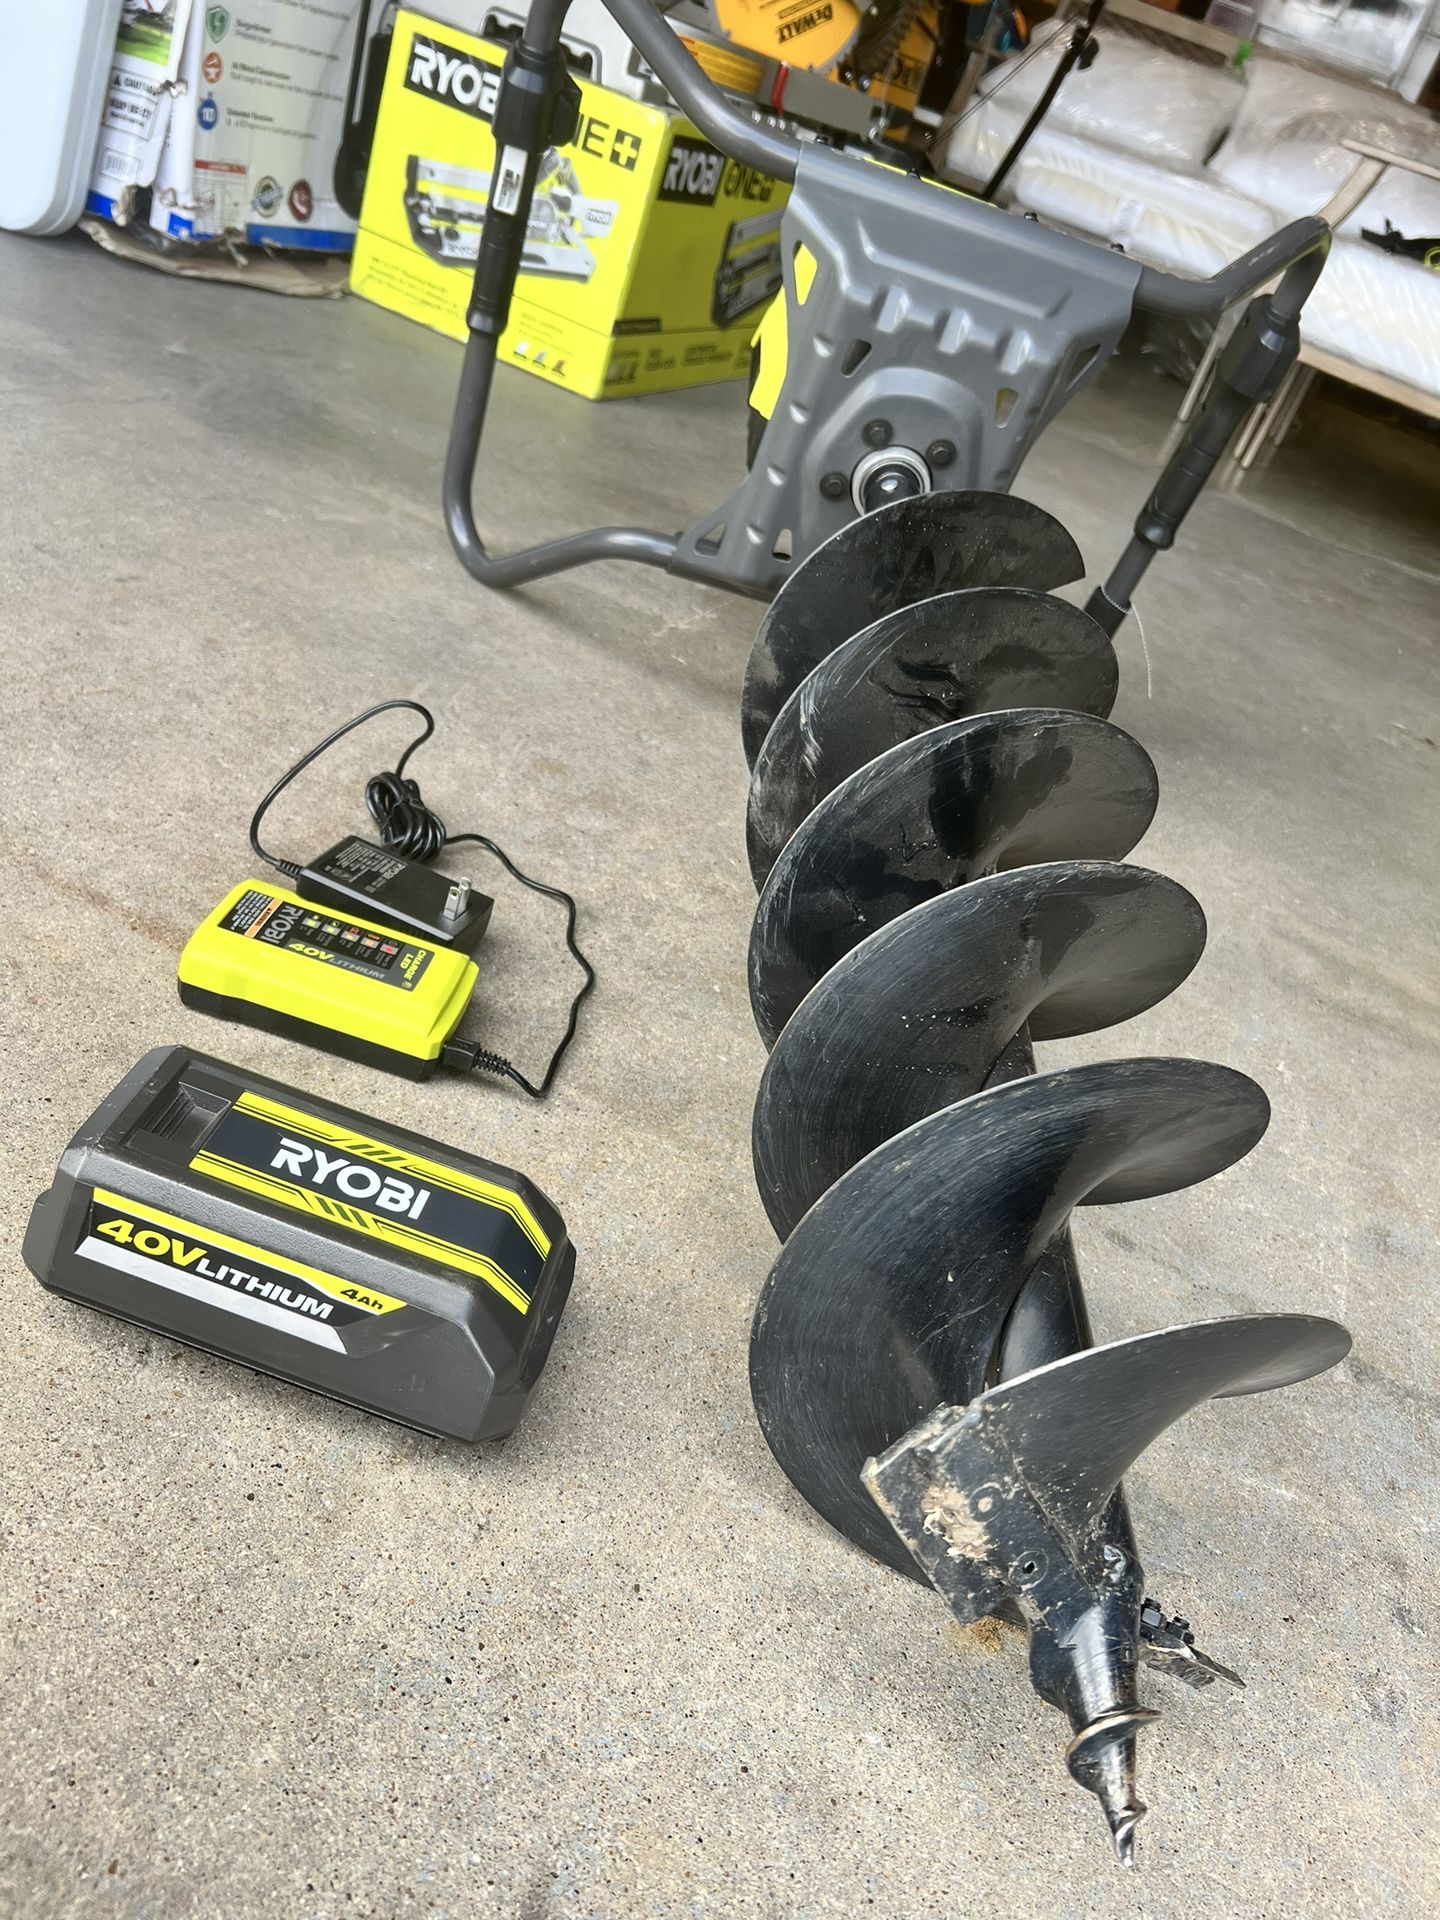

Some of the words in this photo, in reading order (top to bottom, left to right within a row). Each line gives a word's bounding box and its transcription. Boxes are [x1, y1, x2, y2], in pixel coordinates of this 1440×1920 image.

[410, 41, 501, 116] RYOB
[662, 146, 726, 196] RYOBI
[261, 905, 304, 944] RYOBI
[400, 953, 414, 970] LED
[403, 950, 426, 980] CHARGE
[270, 1137, 431, 1220] RYOBI
[96, 1219, 208, 1267] 40V
[195, 1257, 334, 1319] LITHIUM
[340, 1288, 383, 1310] 4Ah
